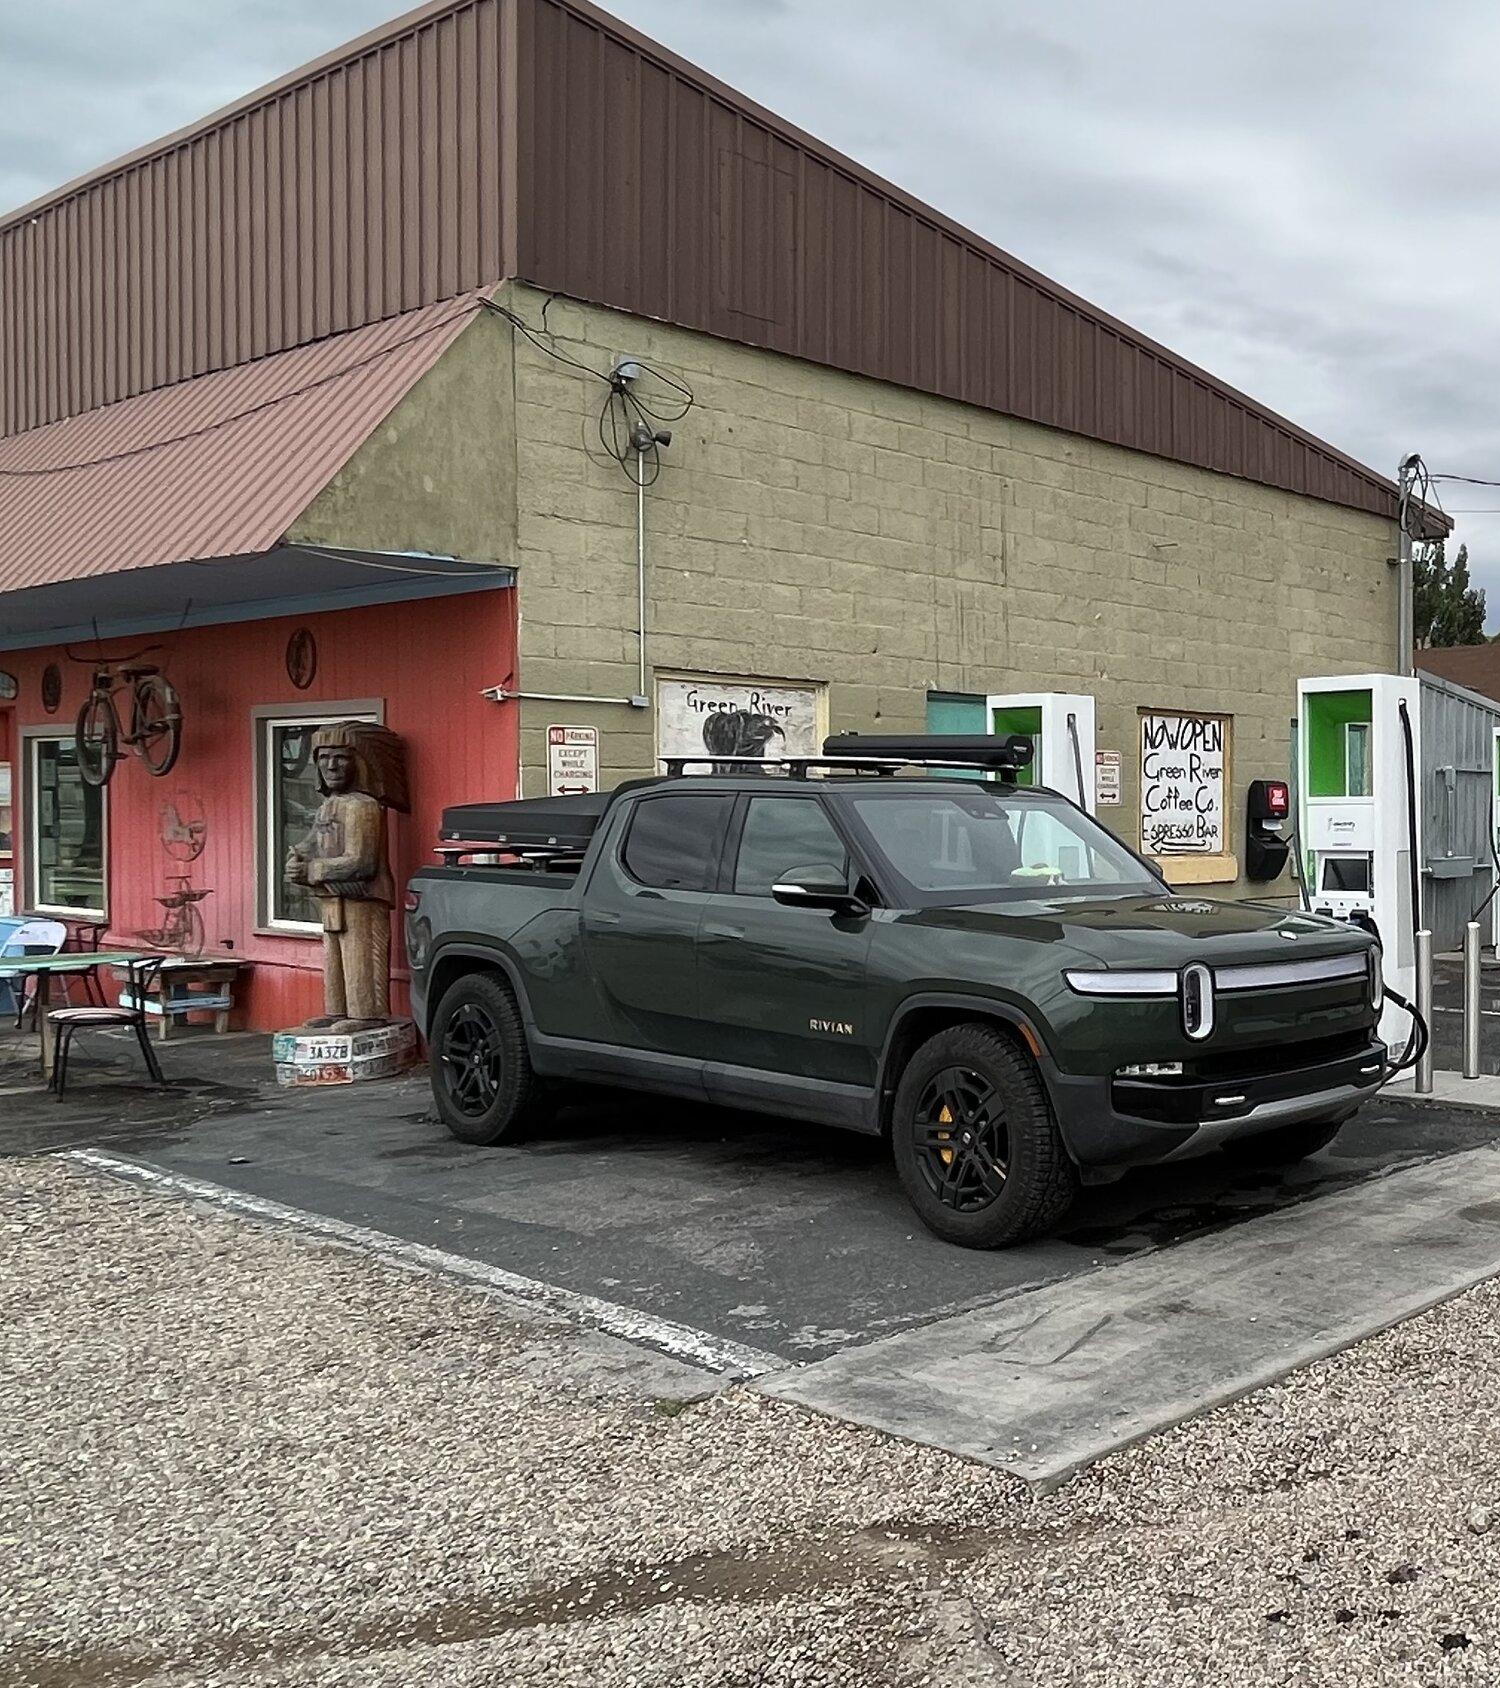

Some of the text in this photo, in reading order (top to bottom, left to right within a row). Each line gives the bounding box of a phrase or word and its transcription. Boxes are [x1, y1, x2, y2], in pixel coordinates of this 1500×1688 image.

[686, 689, 793, 717] Green River
[550, 729, 564, 743] NO
[1143, 715, 1222, 752] NOW OPEN
[558, 749, 588, 758] EXCEPT
[553, 770, 594, 779] CHARGING
[1143, 752, 1223, 784] Green River
[1145, 784, 1219, 813] Coffee Co.
[809, 1018, 853, 1035] RIVIAN
